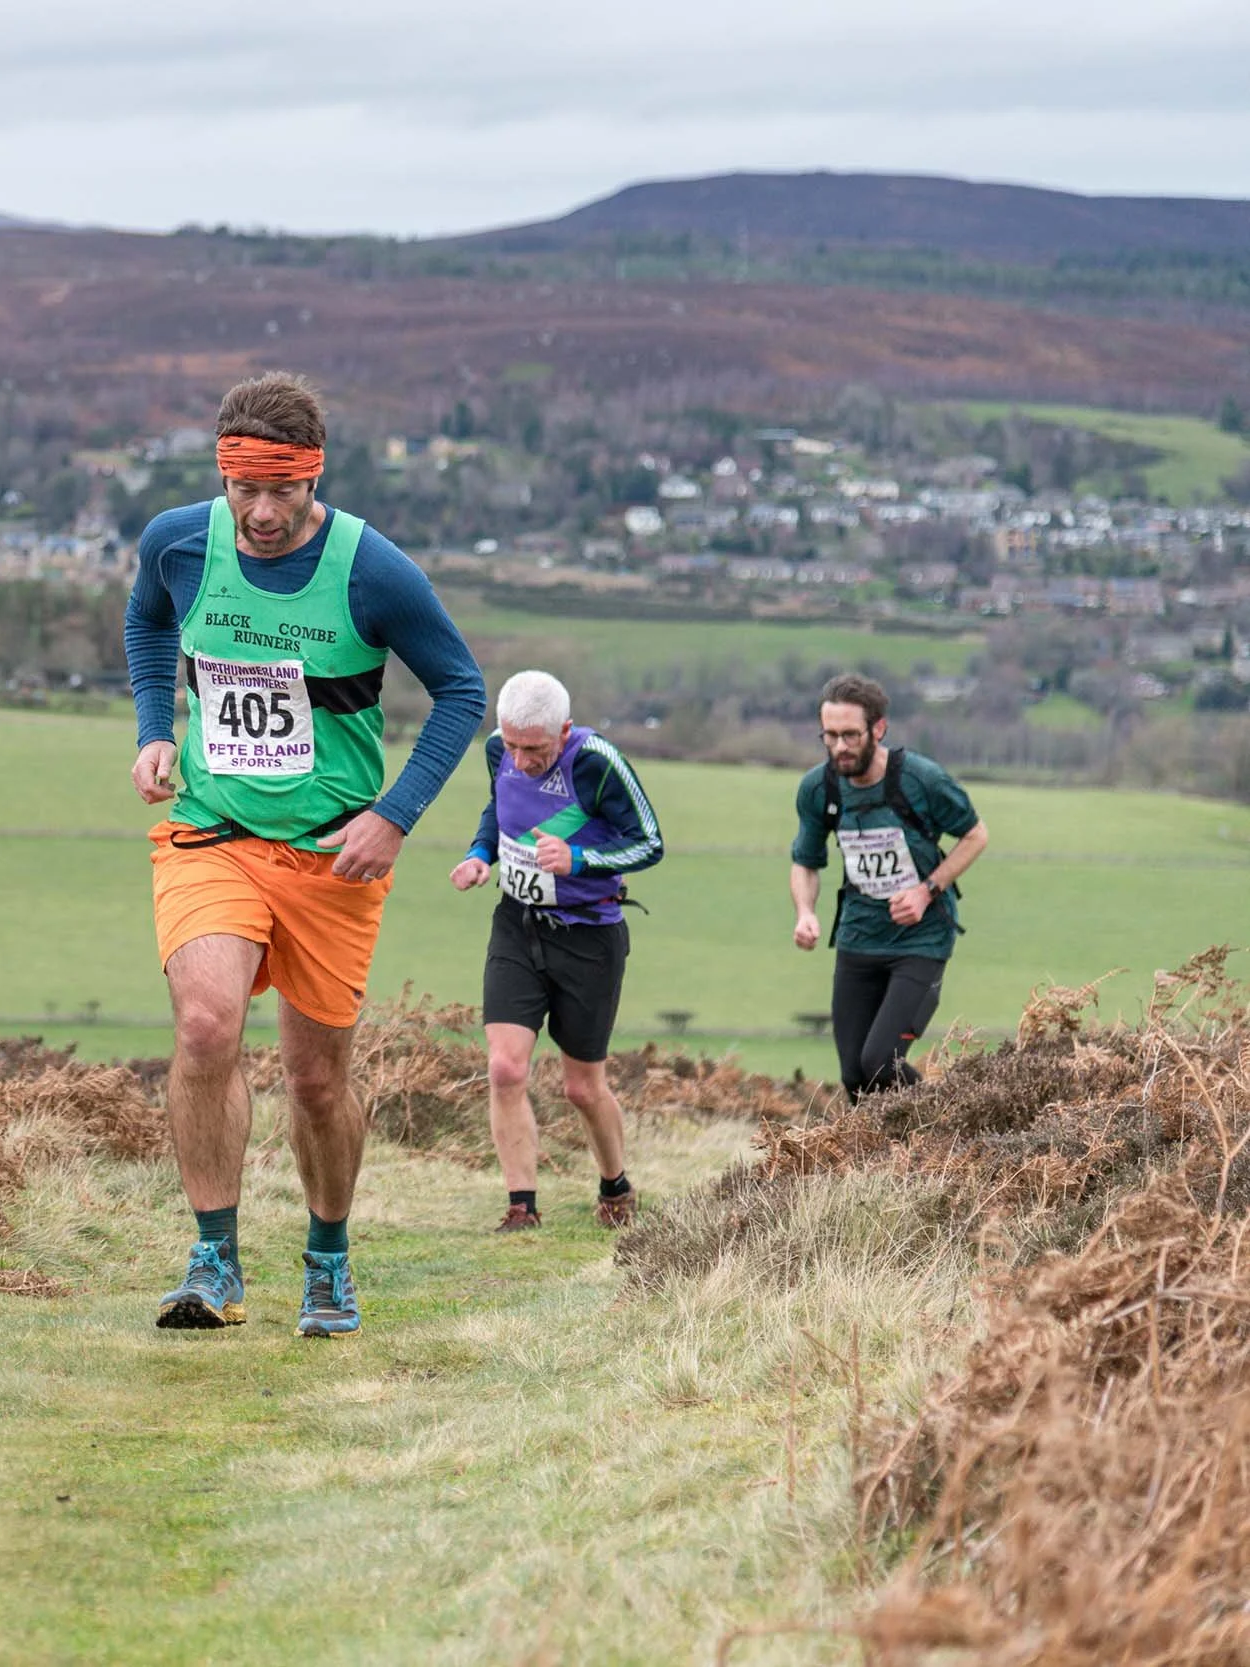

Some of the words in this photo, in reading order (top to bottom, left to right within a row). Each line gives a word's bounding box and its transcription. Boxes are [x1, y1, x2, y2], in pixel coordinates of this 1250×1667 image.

[205, 613, 251, 628] BLACK
[279, 623, 336, 643] COMBE
[233, 630, 301, 653] RUNNERS
[198, 658, 299, 680] NORTHUMBERLAND
[211, 674, 236, 686] FELL
[239, 677, 289, 690] RUNNERS
[218, 691, 294, 739] 405
[209, 743, 248, 756] PETE
[254, 743, 311, 756] BLAND
[231, 758, 282, 768] SPORTS
[857, 850, 902, 879] 422
[507, 865, 544, 903] 426
